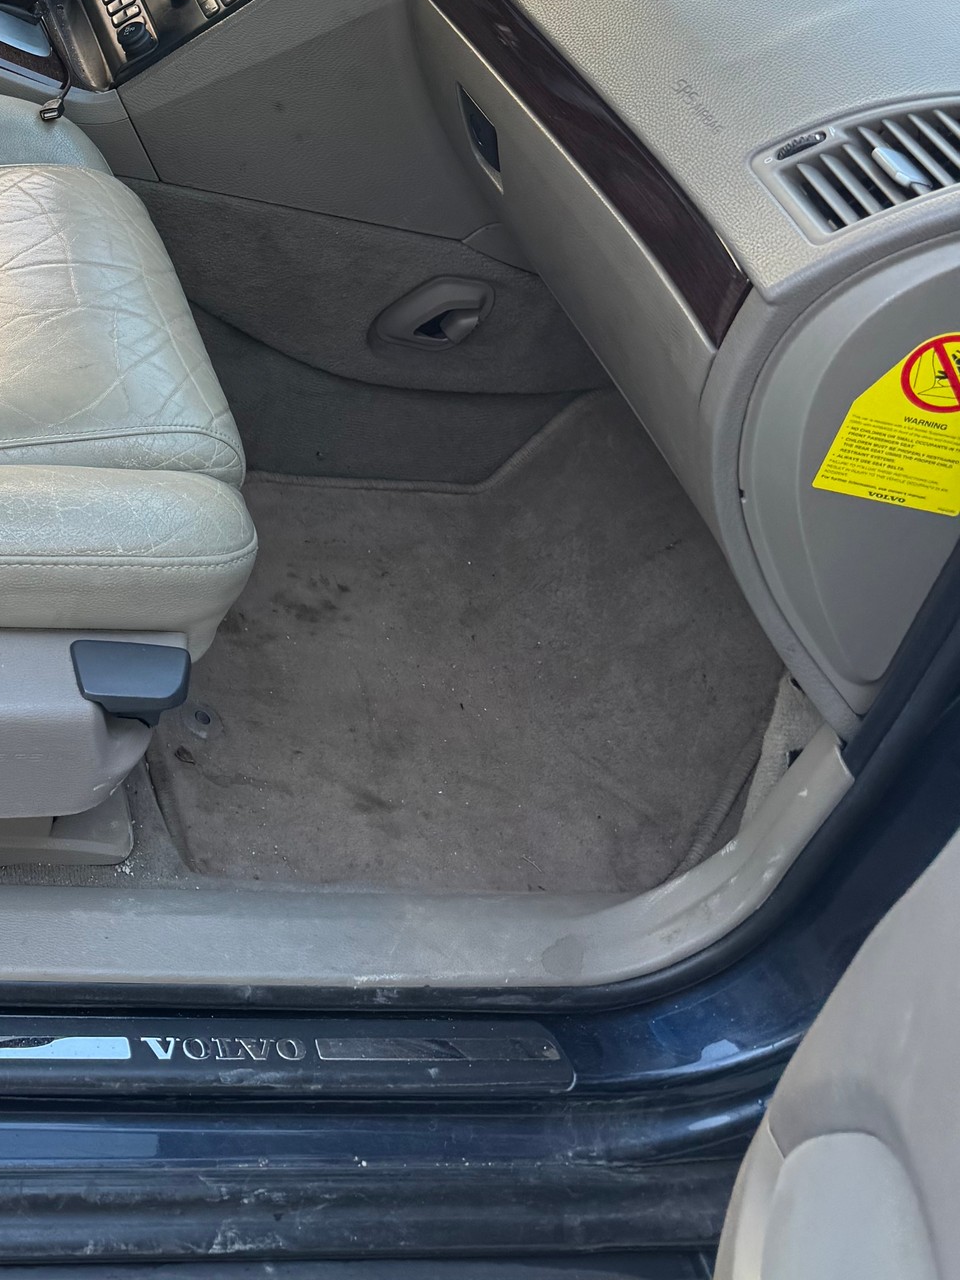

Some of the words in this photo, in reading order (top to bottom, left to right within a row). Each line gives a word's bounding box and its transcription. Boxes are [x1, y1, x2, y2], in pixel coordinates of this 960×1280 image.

[903, 416, 948, 431] WARNING
[868, 491, 906, 503] VOLVO
[140, 1036, 307, 1061] VOLVO
